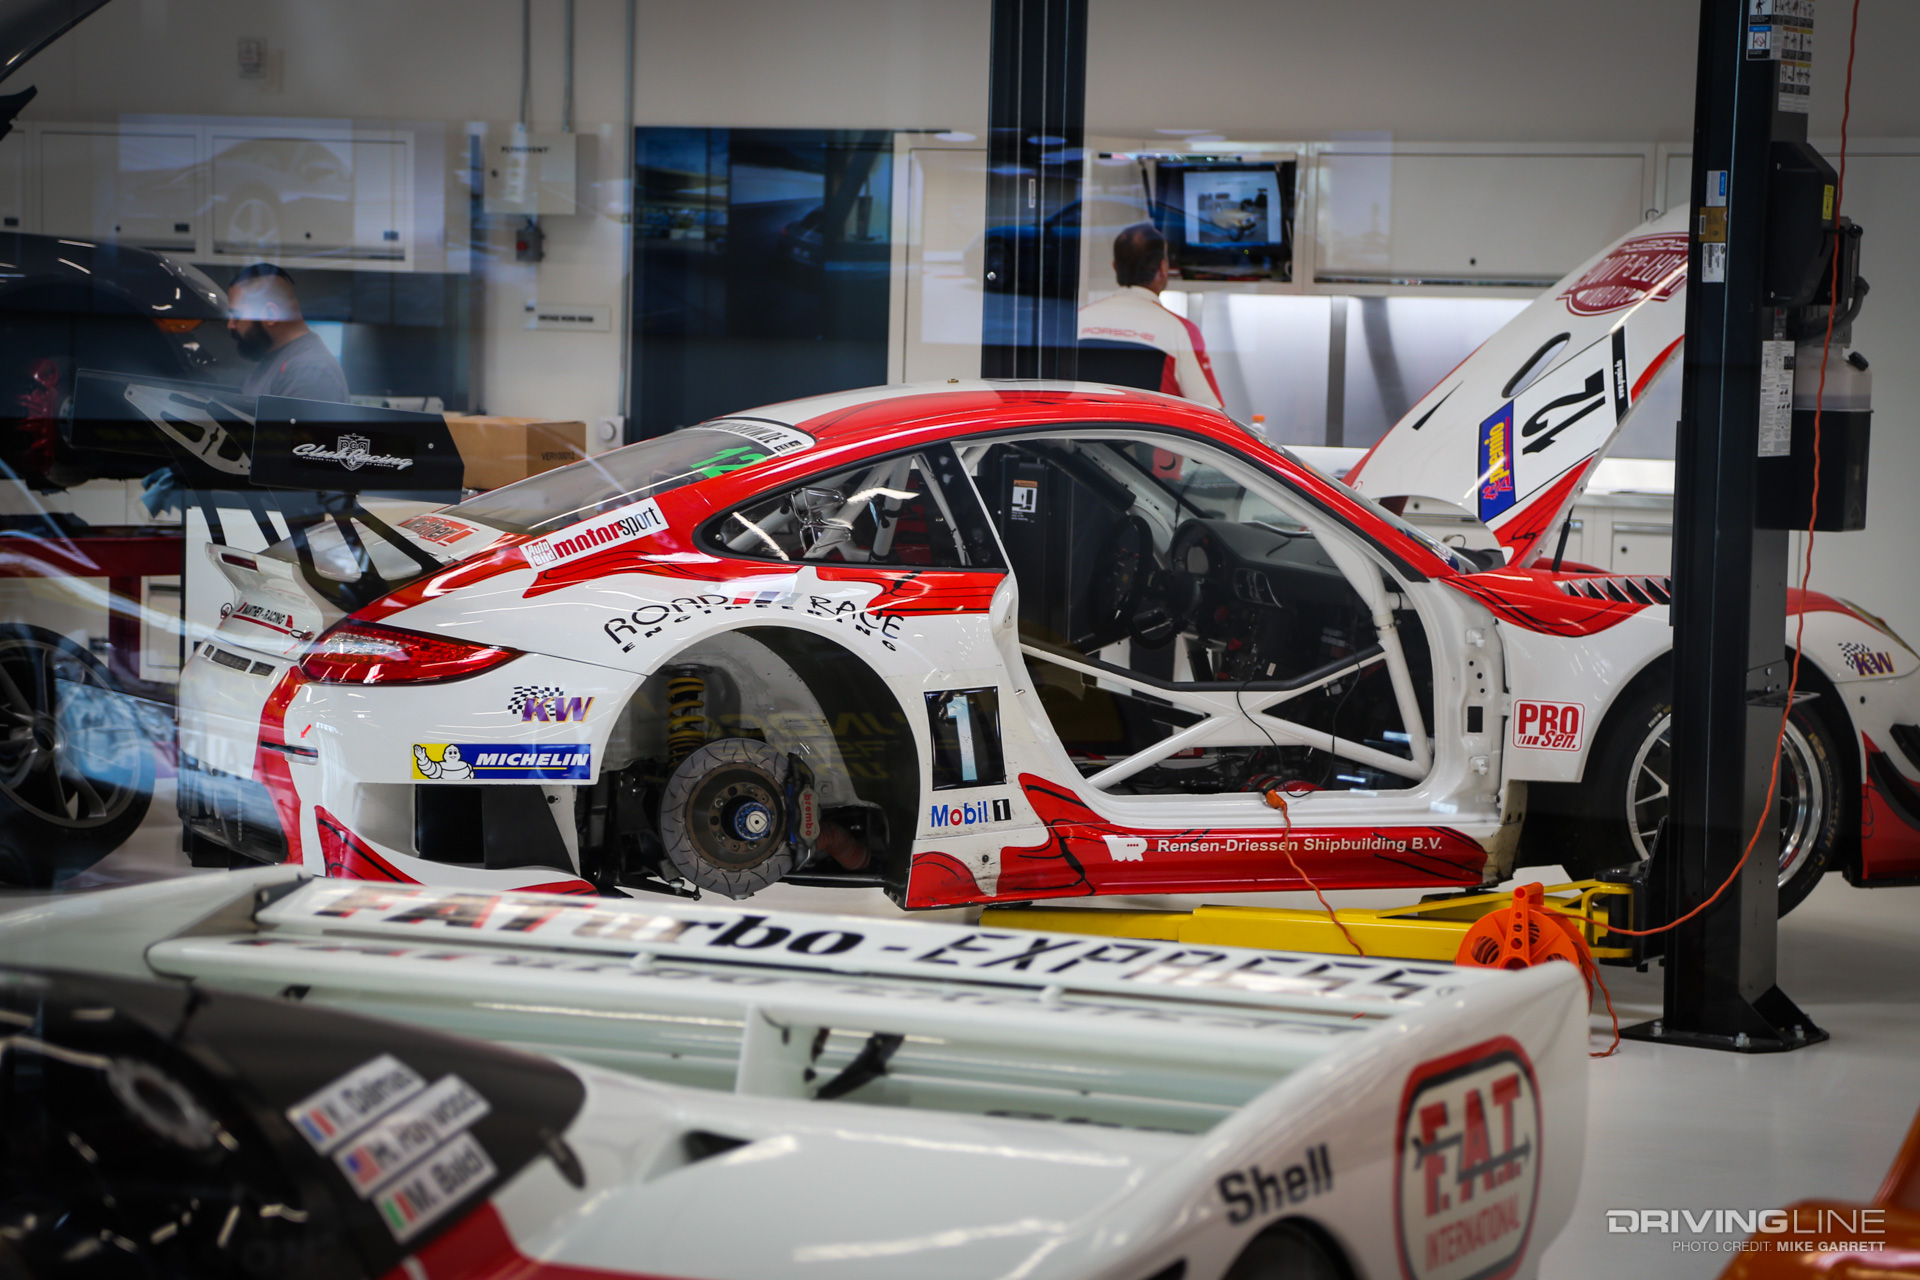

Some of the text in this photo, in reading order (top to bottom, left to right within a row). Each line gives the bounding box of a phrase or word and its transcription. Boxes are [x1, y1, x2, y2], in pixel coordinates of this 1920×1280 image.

[1081, 326, 1155, 341] PORSCHE
[292, 443, 414, 471] Club Racing
[1484, 421, 1509, 484] premio
[527, 540, 551, 556] Auto
[532, 550, 557, 567] Bild
[603, 594, 905, 644] ROAD RACE
[1852, 650, 1896, 677] KW
[521, 697, 596, 723] KW
[1518, 703, 1580, 736] PRO
[946, 694, 979, 782] 1
[1540, 729, 1577, 749] Sen.
[475, 753, 590, 767] MICHELIN
[803, 793, 813, 837] brembo
[931, 800, 989, 828] Mobil
[1156, 837, 1443, 853] Rensen-Driessen Shipbuilding B.V.
[1217, 1143, 1333, 1227] Shell
[1424, 1192, 1521, 1273] INTERNATIONAL
